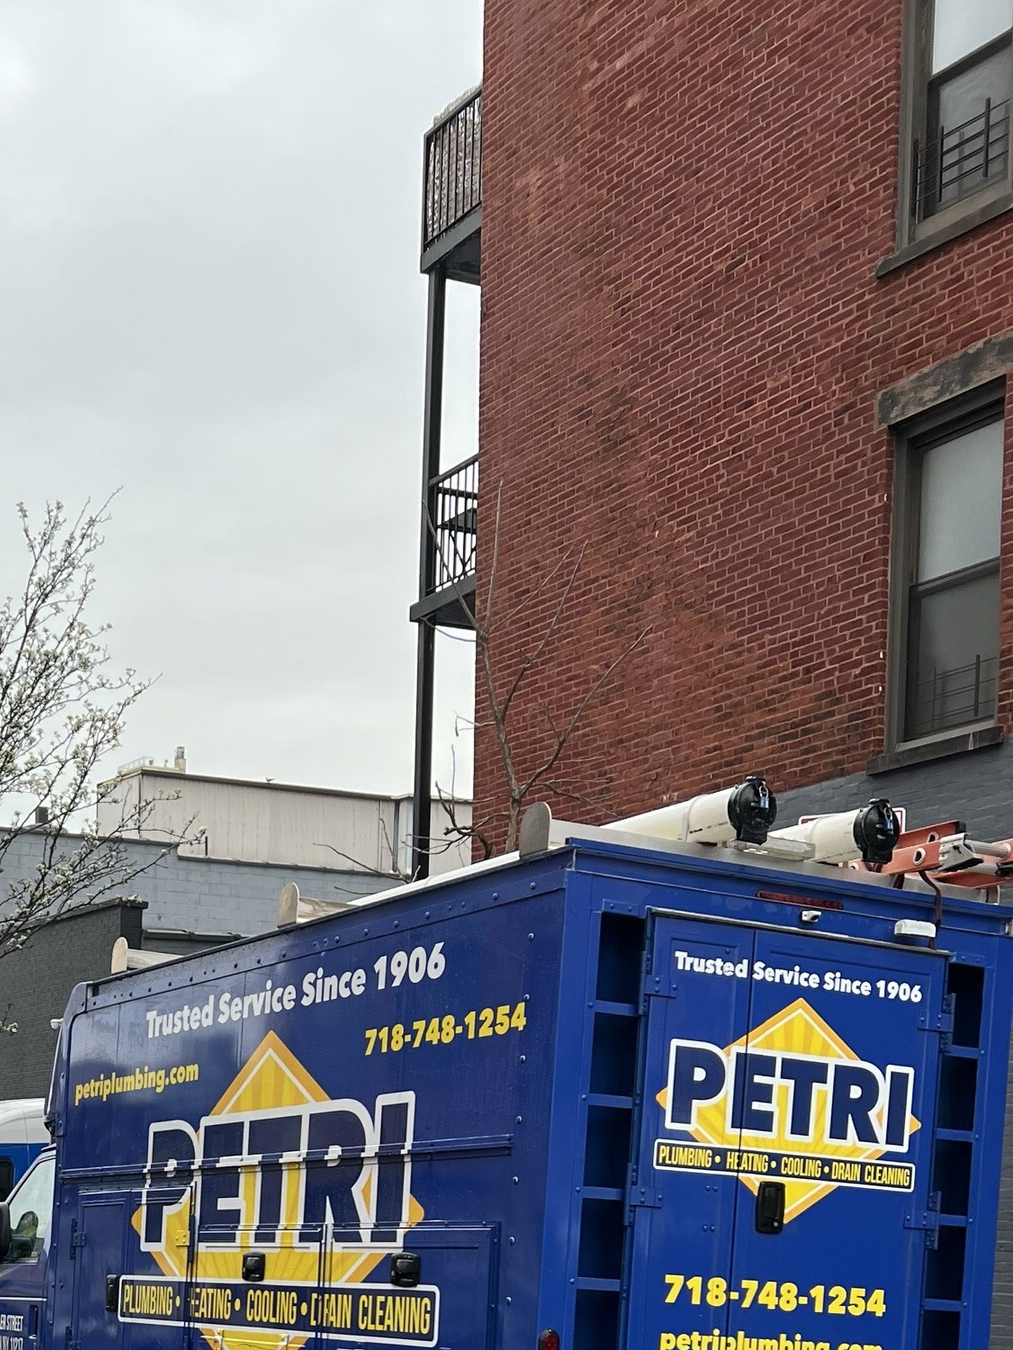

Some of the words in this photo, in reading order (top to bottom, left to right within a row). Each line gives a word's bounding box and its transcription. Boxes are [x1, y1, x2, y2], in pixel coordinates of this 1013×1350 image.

[146, 995, 215, 1039] Trusted
[217, 979, 297, 1024] Service
[300, 967, 366, 1009] Since
[373, 942, 446, 991] 1906
[675, 951, 748, 979] Trusted
[752, 962, 820, 989] Service
[823, 971, 872, 996] Since
[875, 979, 922, 1003] 1906
[364, 1002, 527, 1056] 718-748-1254
[74, 1060, 199, 1106] petriplumbing.com
[664, 1038, 916, 1153] PETRI
[139, 1090, 416, 1254] PETRI
[658, 1145, 712, 1168] PLUMBING
[726, 1151, 769, 1173] HEATING
[781, 1156, 822, 1178] COOLING
[831, 1161, 861, 1181] DRAIN
[864, 1165, 910, 1186] CLEANING
[123, 1284, 174, 1316] PLUMBING
[188, 1288, 232, 1320] EATING
[246, 1289, 298, 1325] COOLING
[358, 1294, 431, 1335] CLEANING
[664, 1274, 886, 1317] 718-748-1254
[6, 1314, 24, 1331] STREET
